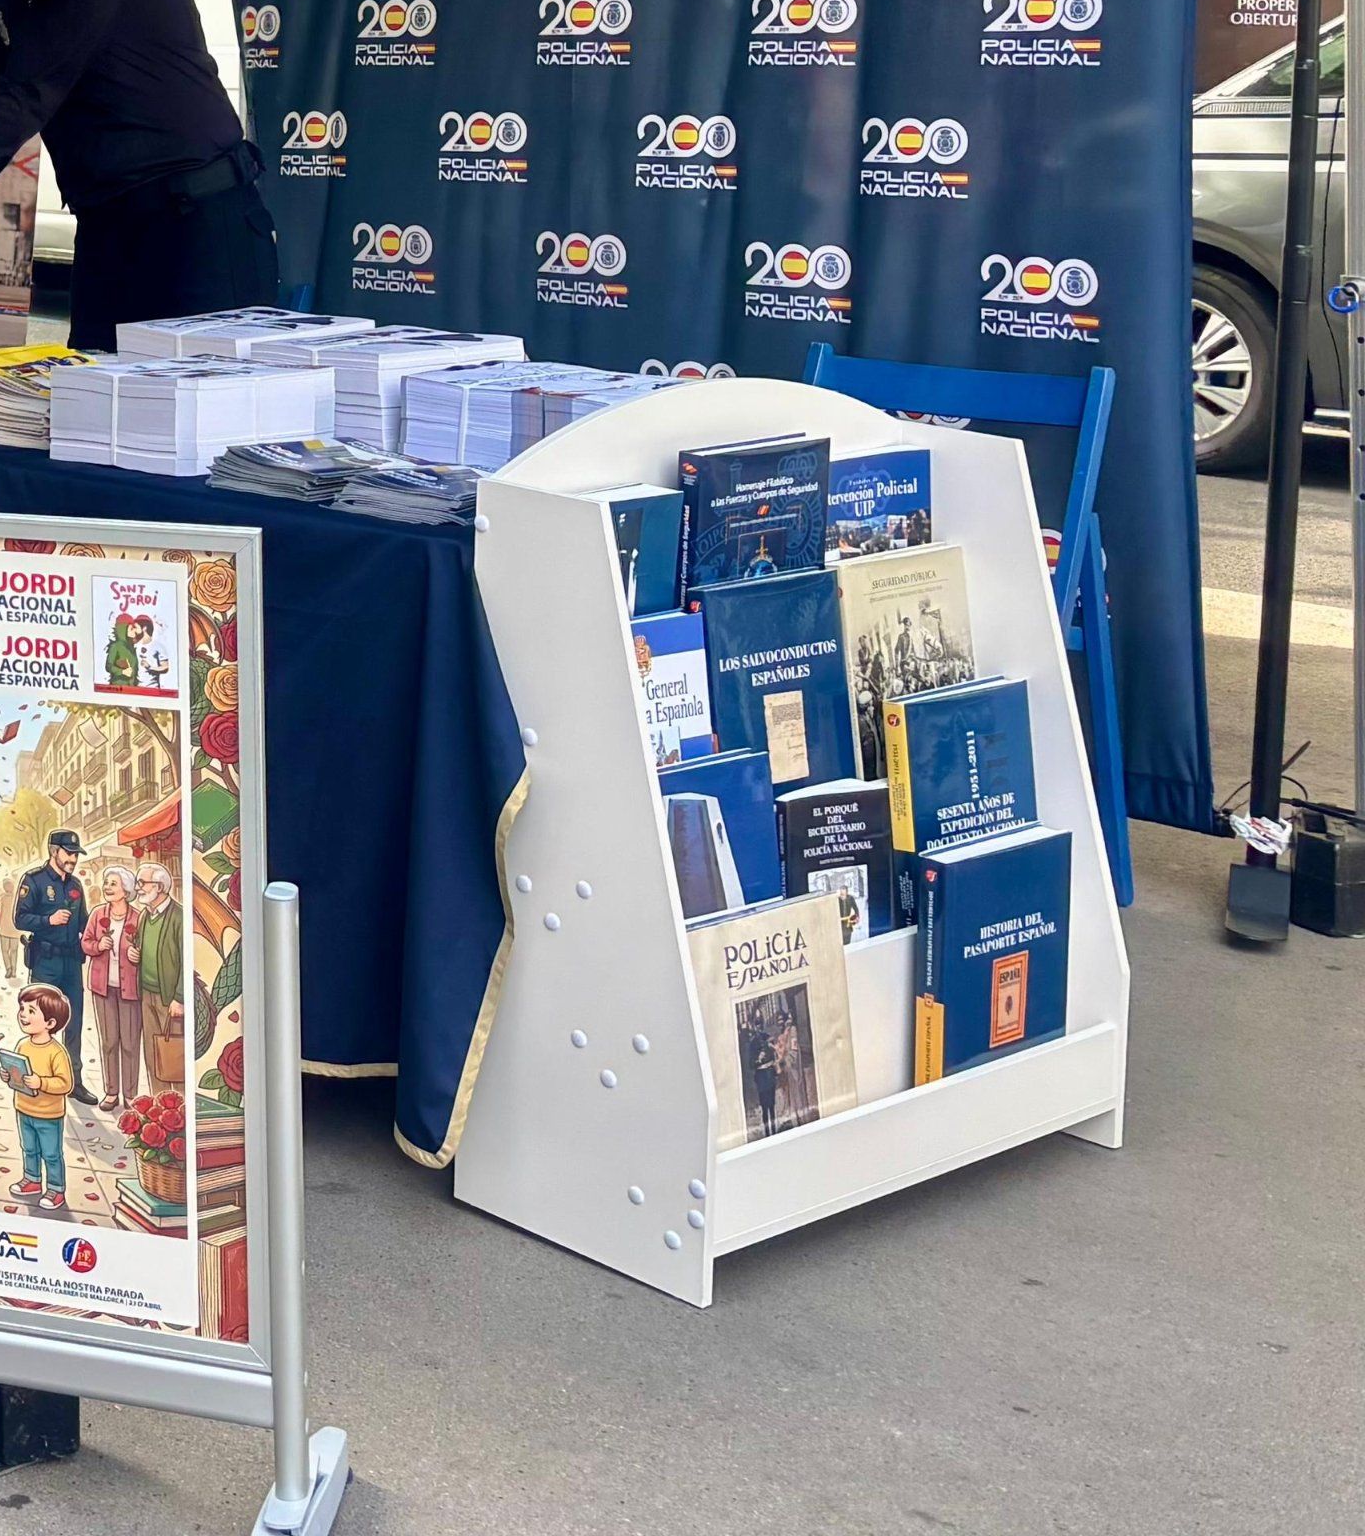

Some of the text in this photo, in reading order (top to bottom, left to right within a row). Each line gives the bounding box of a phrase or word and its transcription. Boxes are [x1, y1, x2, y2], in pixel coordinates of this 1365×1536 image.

[355, 54, 435, 65] NACIONAL
[537, 53, 631, 65] NACIONAL
[748, 53, 856, 66] NACIONAL
[981, 52, 1101, 66] NACIONAL
[438, 169, 527, 183] NACIONAL
[635, 175, 737, 191] NACIONAL
[860, 183, 968, 199] NACIONAL
[352, 279, 436, 295] NACIONAL
[536, 291, 629, 309] NACIONAL
[744, 306, 851, 325] NACIONAL
[979, 323, 1100, 343] NACIONAL
[778, 487, 787, 497] de
[787, 481, 818, 497] Seguridad
[828, 477, 918, 506] tervención Policial
[854, 500, 876, 517] UIP
[110, 581, 146, 600] SANT
[6, 611, 76, 627] ESPAÑOLA
[2, 635, 78, 660] JORDI
[719, 639, 837, 672] LOS SALVOCONDUCTOS
[0, 674, 79, 690] ESPANYOLA
[751, 663, 811, 687] ESPAÑOLES
[646, 673, 688, 701] General
[655, 695, 704, 727] Española
[813, 807, 823, 817] EL
[937, 792, 1015, 821] SESENTA AÑOS DE
[996, 807, 1014, 821] DEL
[827, 815, 844, 825] DEL
[808, 822, 866, 838] BICENTENARIO
[824, 833, 848, 844] DE LA
[832, 840, 873, 853] NACIONAL
[980, 912, 1043, 940] HISTORIA DEL
[963, 921, 1057, 959] PASAPORTE ESPAÑOL
[726, 952, 810, 991] ESPAÑOLA
[41, 1276, 47, 1285] A
[49, 1278, 61, 1287] LA
[63, 1280, 102, 1294] NOSTRA
[105, 1287, 144, 1300] PARADA
